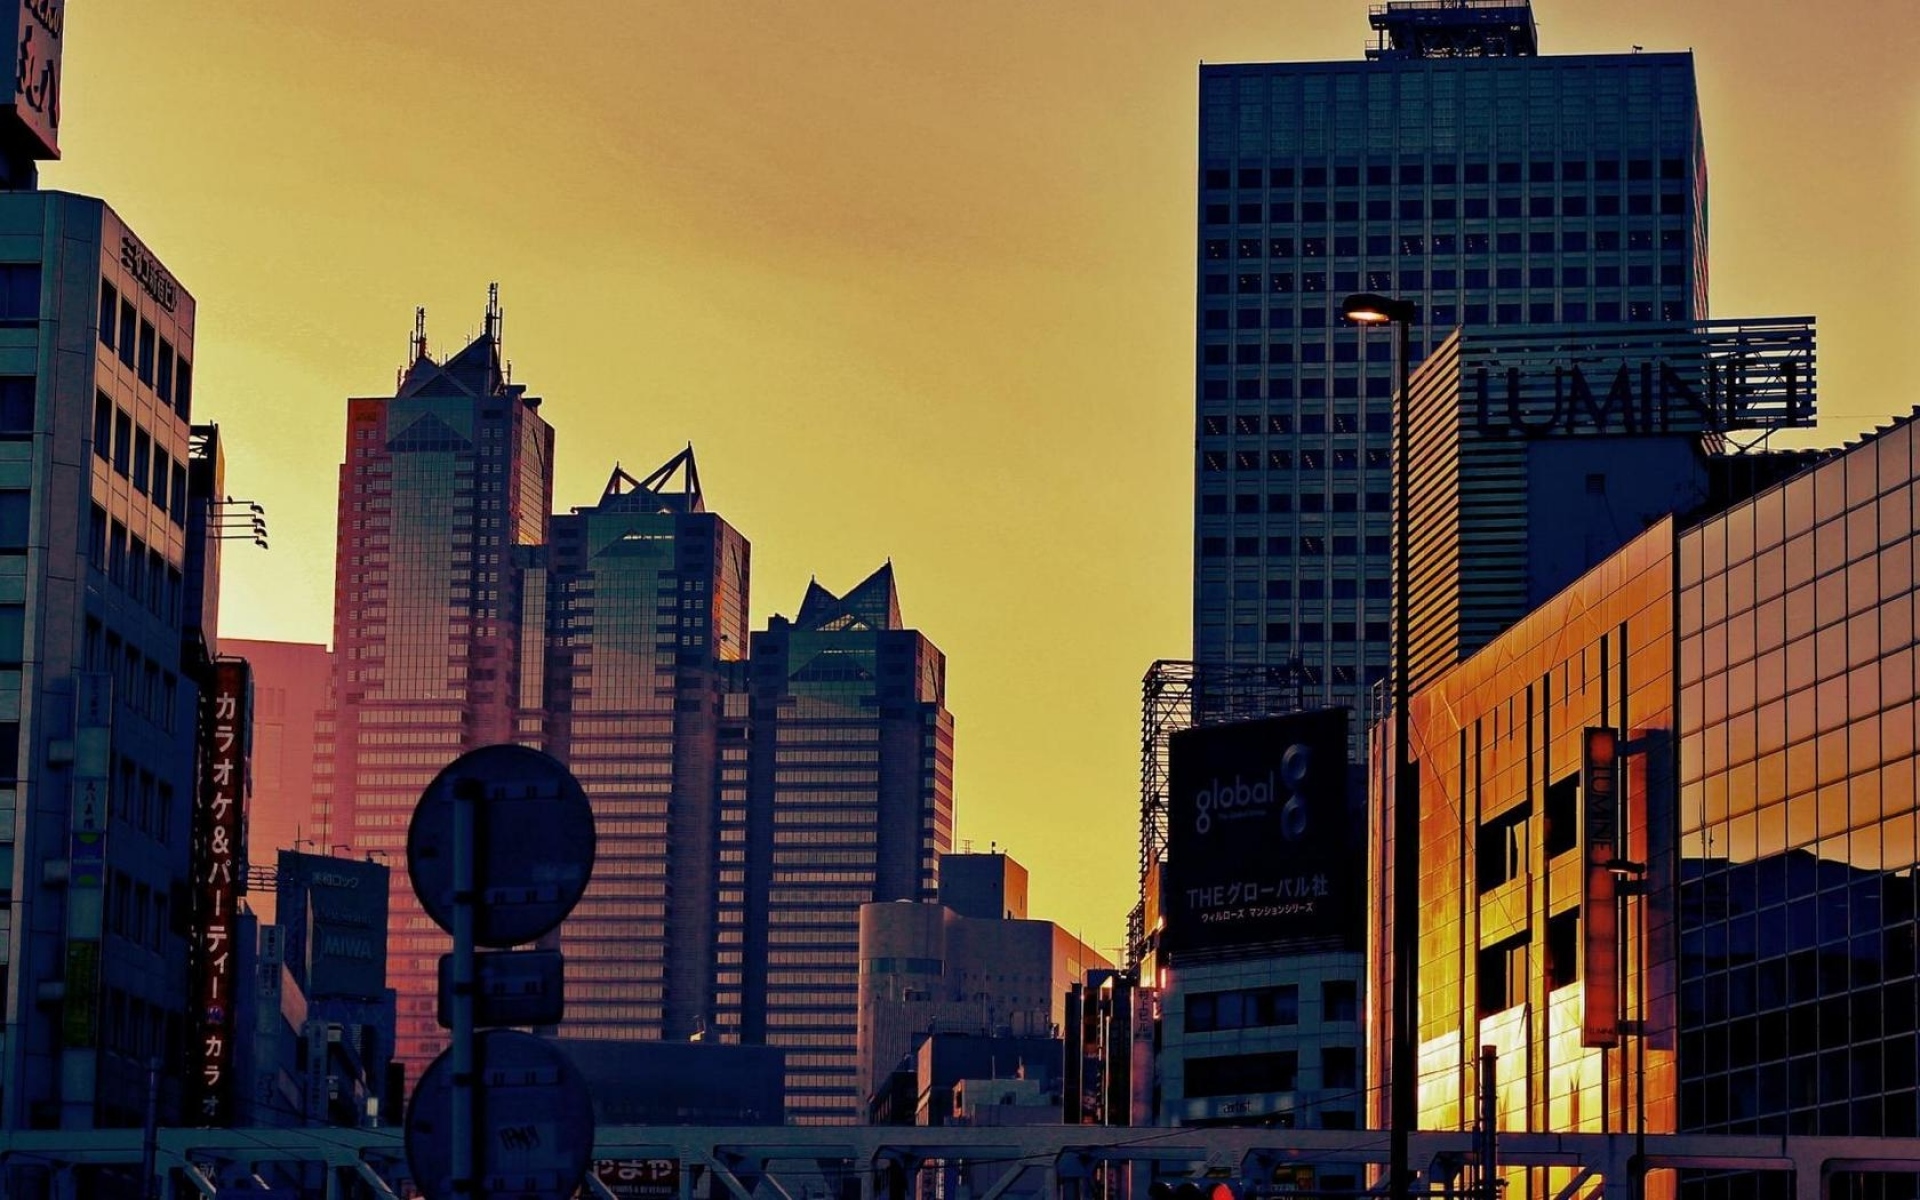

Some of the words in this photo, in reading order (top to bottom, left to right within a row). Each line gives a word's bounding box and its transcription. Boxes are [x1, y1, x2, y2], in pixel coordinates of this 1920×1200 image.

[1478, 361, 1757, 436] LUMINE
[1195, 769, 1275, 835] global
[1591, 766, 1612, 851] LUMINE
[206, 692, 236, 999] カラオケ&パーティー
[323, 935, 373, 959] MIWA
